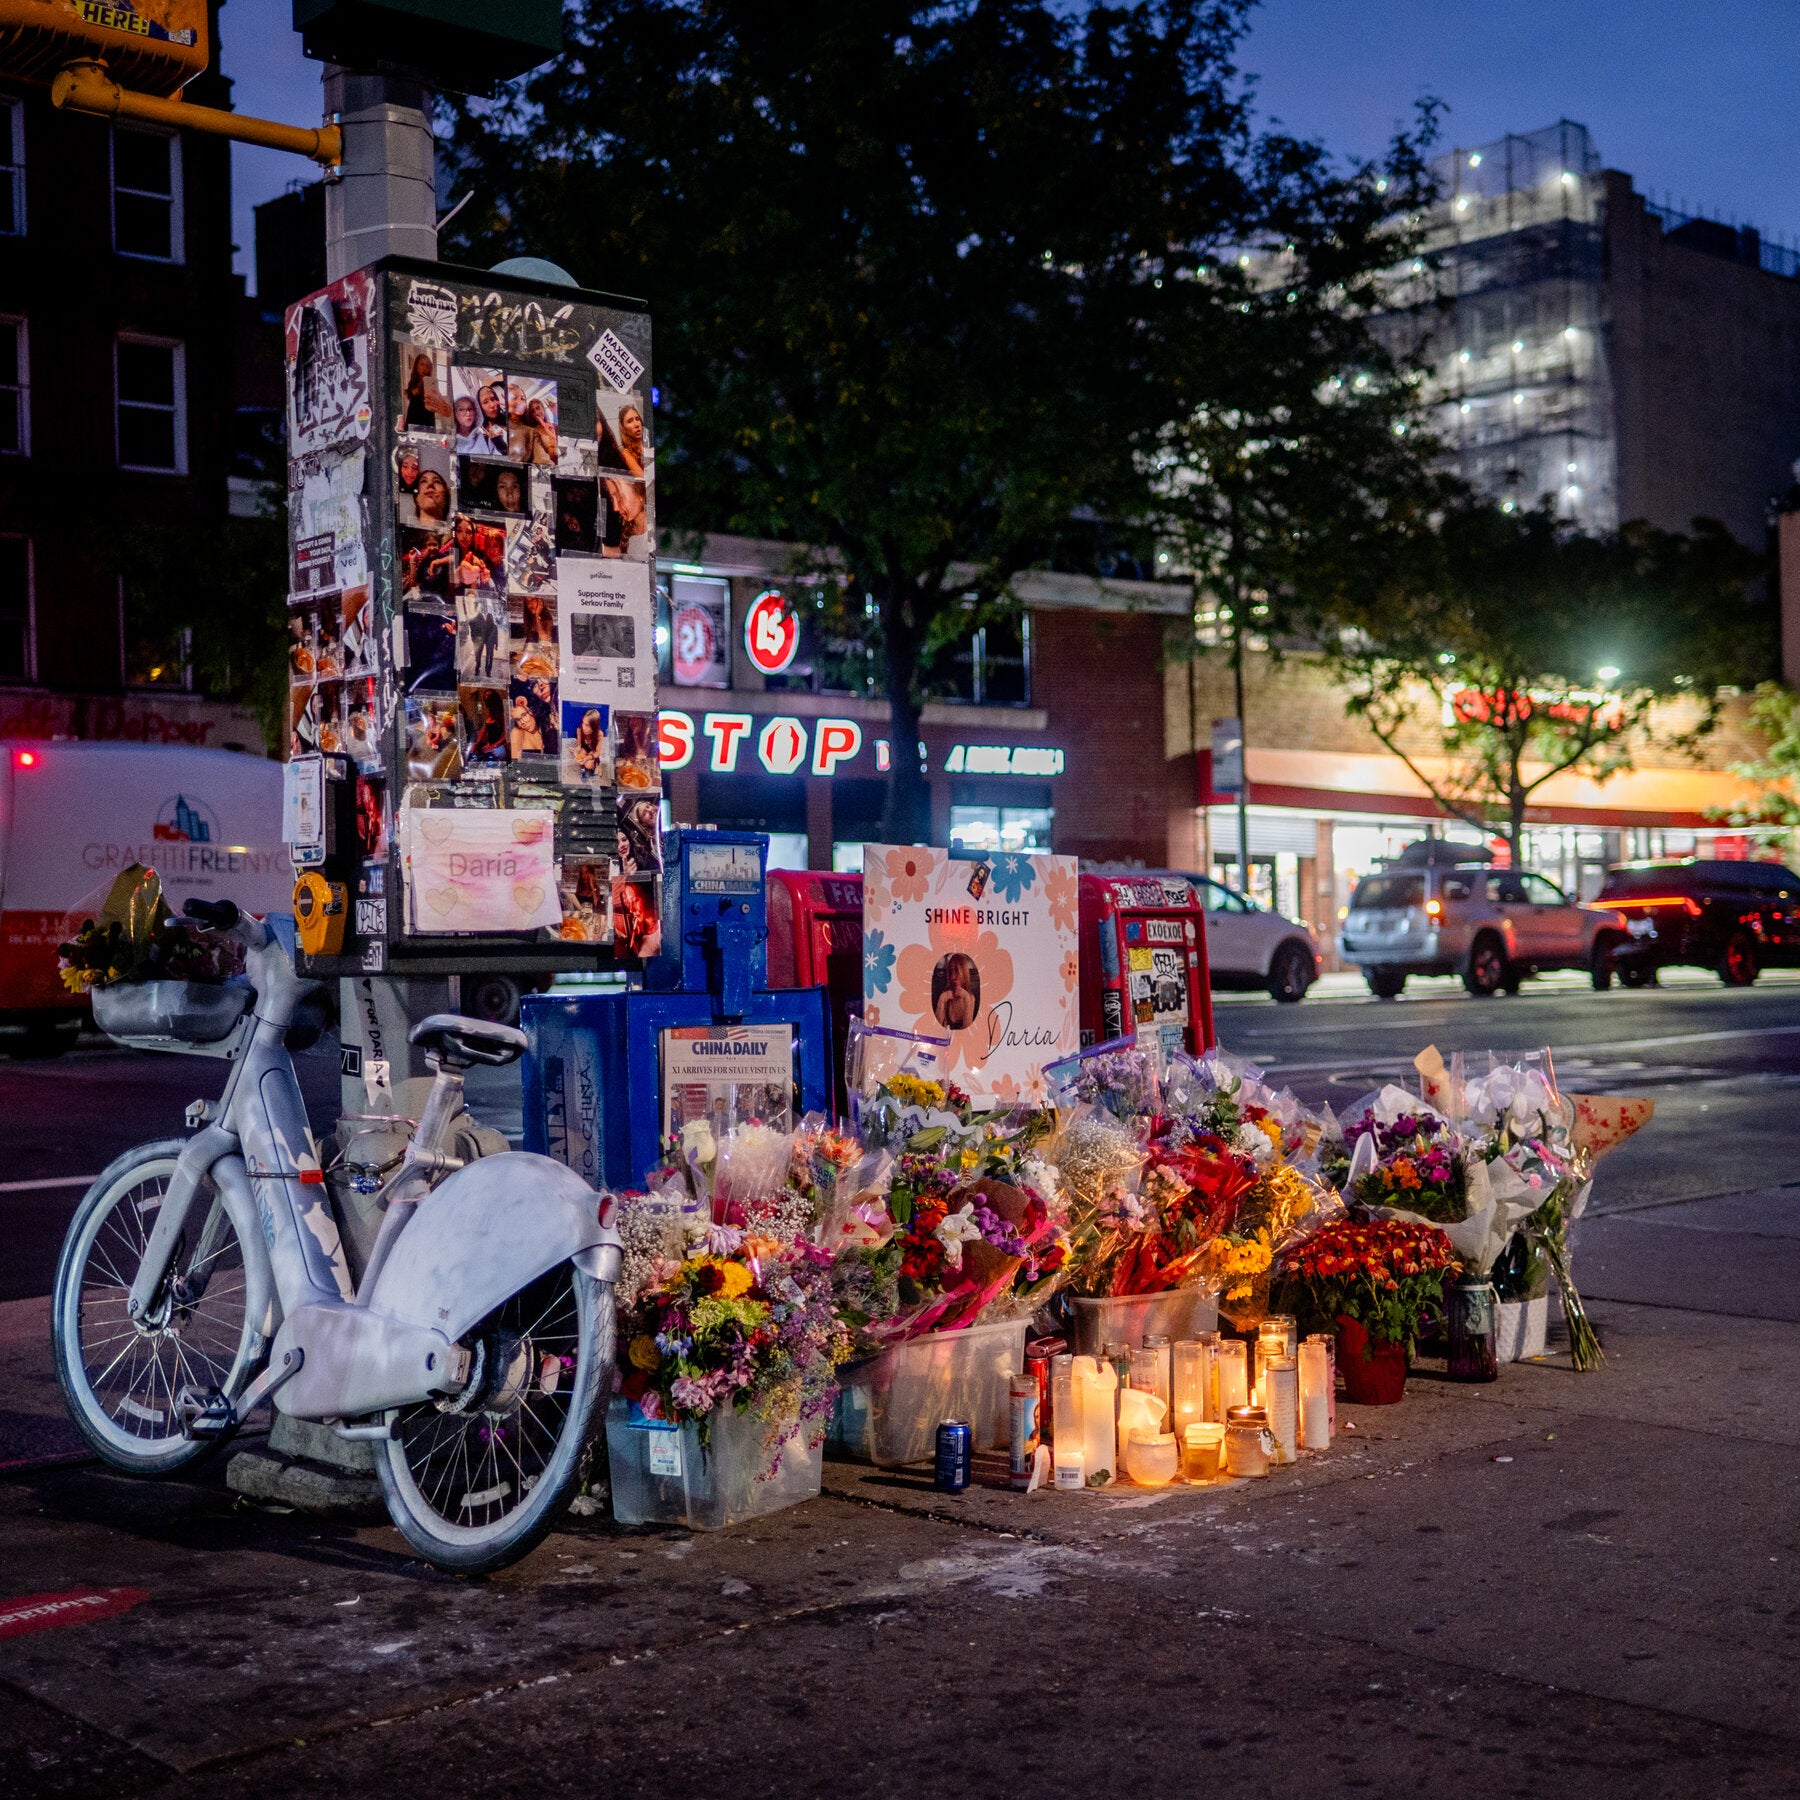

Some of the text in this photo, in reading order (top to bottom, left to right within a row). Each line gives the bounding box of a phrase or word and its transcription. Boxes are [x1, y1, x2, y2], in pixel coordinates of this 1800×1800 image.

[83, 2, 149, 34] HERE!
[320, 330, 342, 360] Fire
[603, 332, 641, 376] MAXELLE
[593, 353, 626, 389] GRIMES
[600, 343, 632, 382] TOPPED
[577, 589, 626, 601] Supporting the
[580, 599, 624, 610] Serkov Family
[659, 710, 863, 776] STOP
[450, 851, 518, 879] Daria
[694, 880, 726, 891] CHINA
[925, 908, 1029, 926] SHINE BRIGHT
[364, 998, 385, 1074] FOR DARIA
[980, 1001, 1061, 1061] Daria
[691, 1041, 769, 1056] CHINA DAILY
[672, 1065, 787, 1075] XI ARRIVES FOR STATE VISIT IN US
[545, 1090, 567, 1163] AILY
[580, 1065, 594, 1180] TO CHINA
